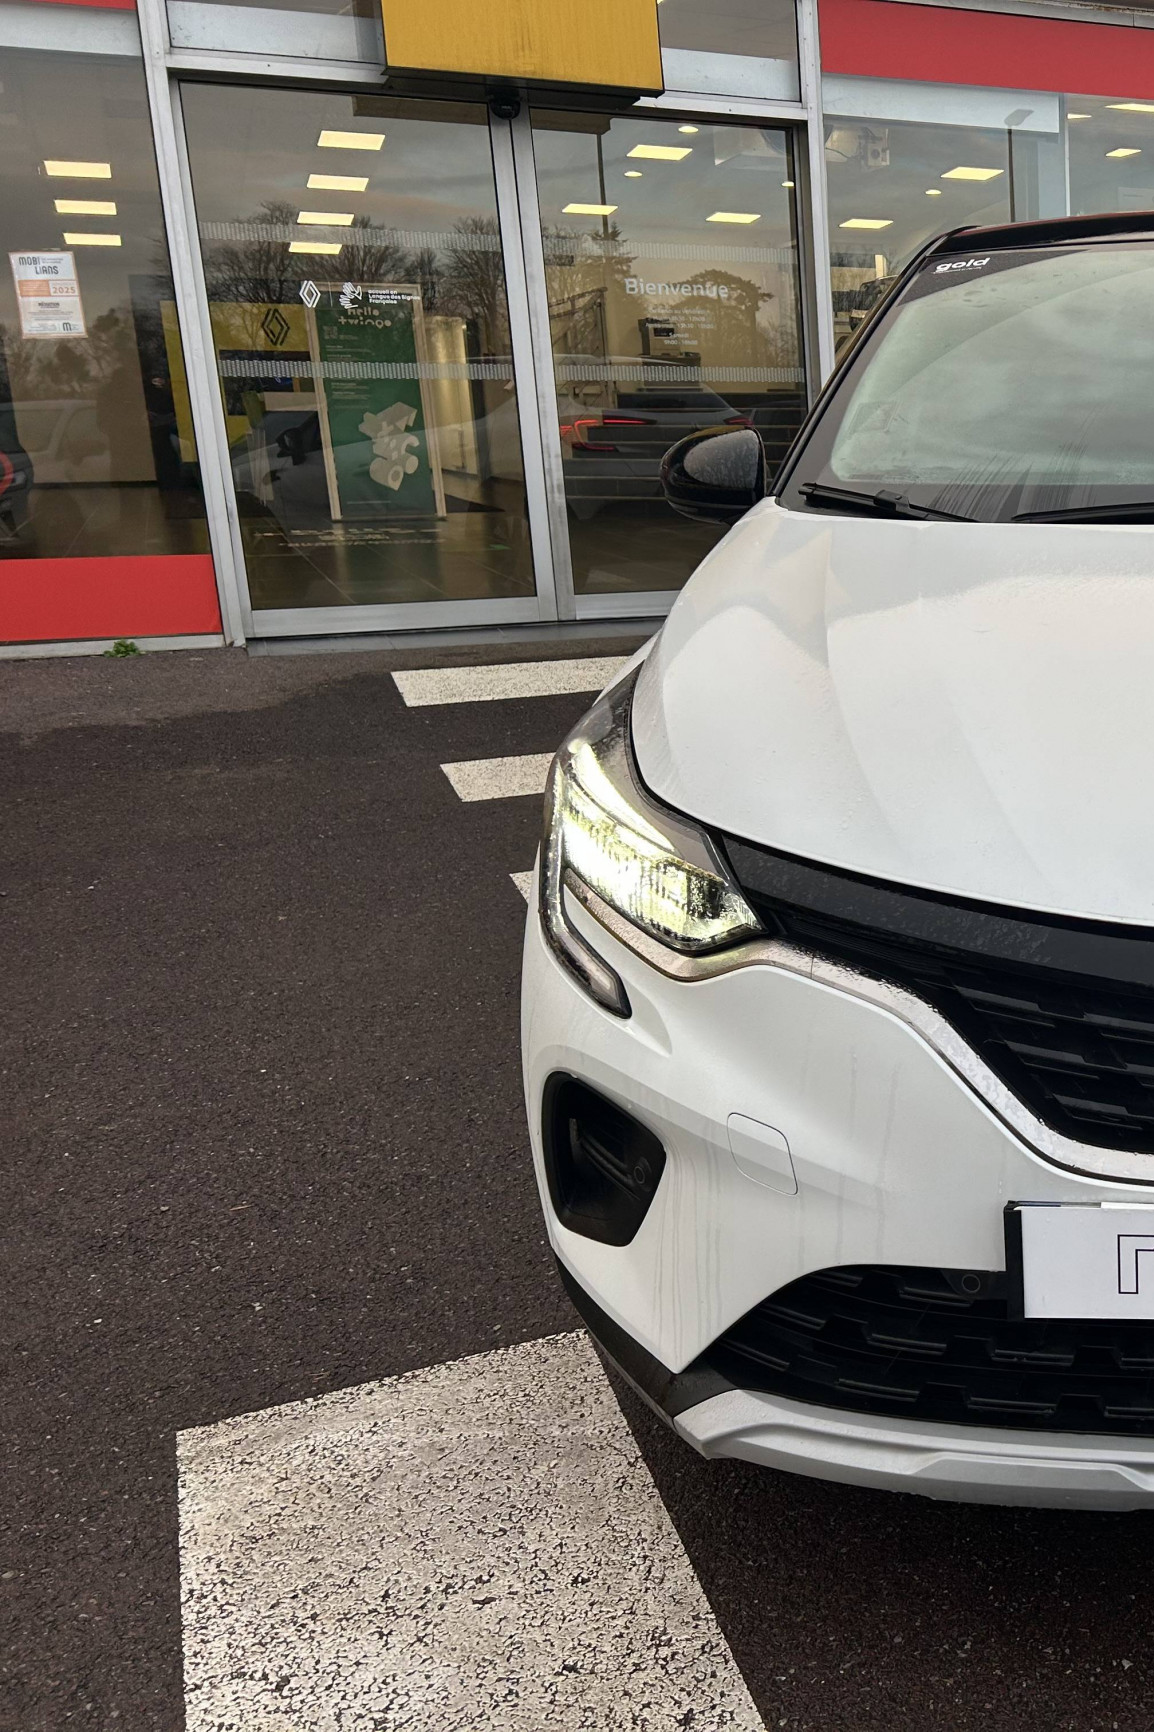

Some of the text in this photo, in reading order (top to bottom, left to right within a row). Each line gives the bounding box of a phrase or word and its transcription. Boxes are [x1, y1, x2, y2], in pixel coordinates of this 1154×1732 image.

[935, 257, 991, 273] gold
[52, 286, 76, 294] 2025
[624, 278, 729, 299] Bienvenue
